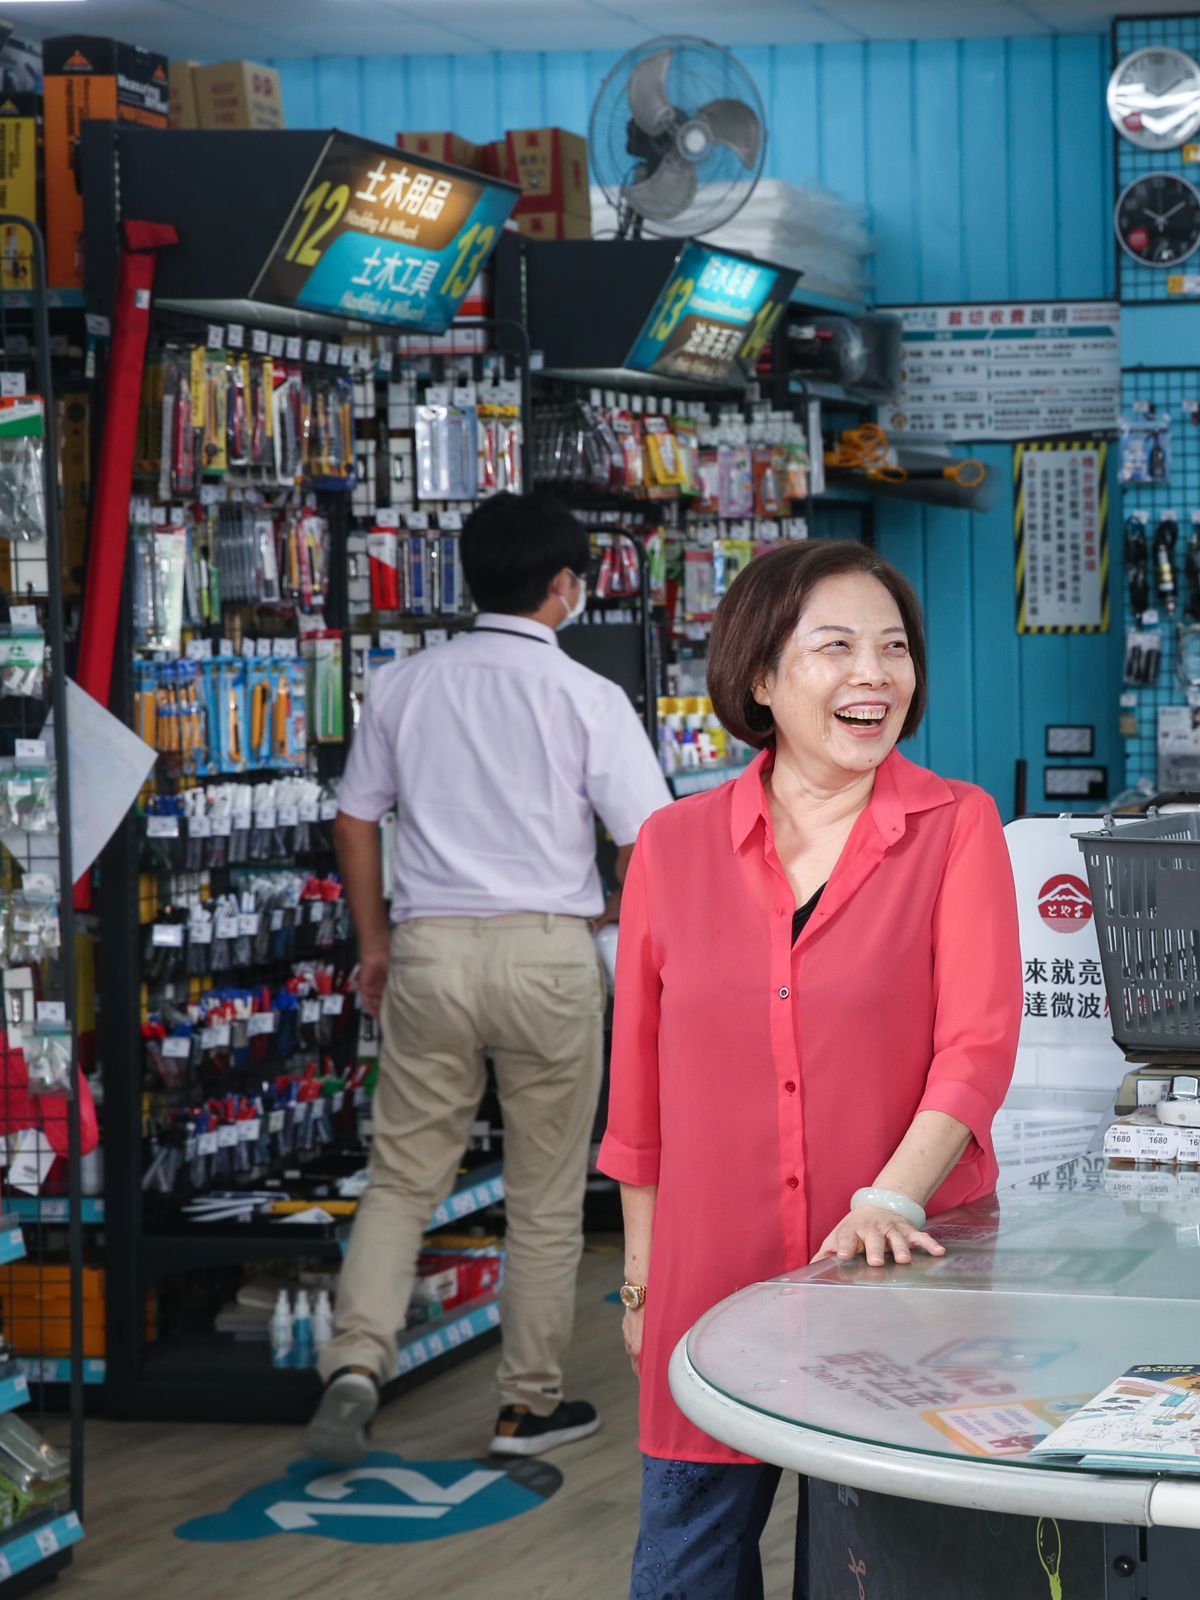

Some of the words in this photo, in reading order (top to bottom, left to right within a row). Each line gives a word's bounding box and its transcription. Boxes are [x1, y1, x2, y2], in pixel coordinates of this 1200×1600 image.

[355, 160, 452, 221] 土木用品
[285, 181, 350, 267] 12
[351, 247, 441, 299] 土木工具
[440, 222, 496, 298] 13
[649, 276, 695, 342] 13
[1024, 958, 1102, 986] 來就亮
[1024, 991, 1111, 1019] 達微波
[1112, 1135, 1131, 1143] 1680
[1150, 1136, 1168, 1145] 1680
[264, 1467, 507, 1531] 12
